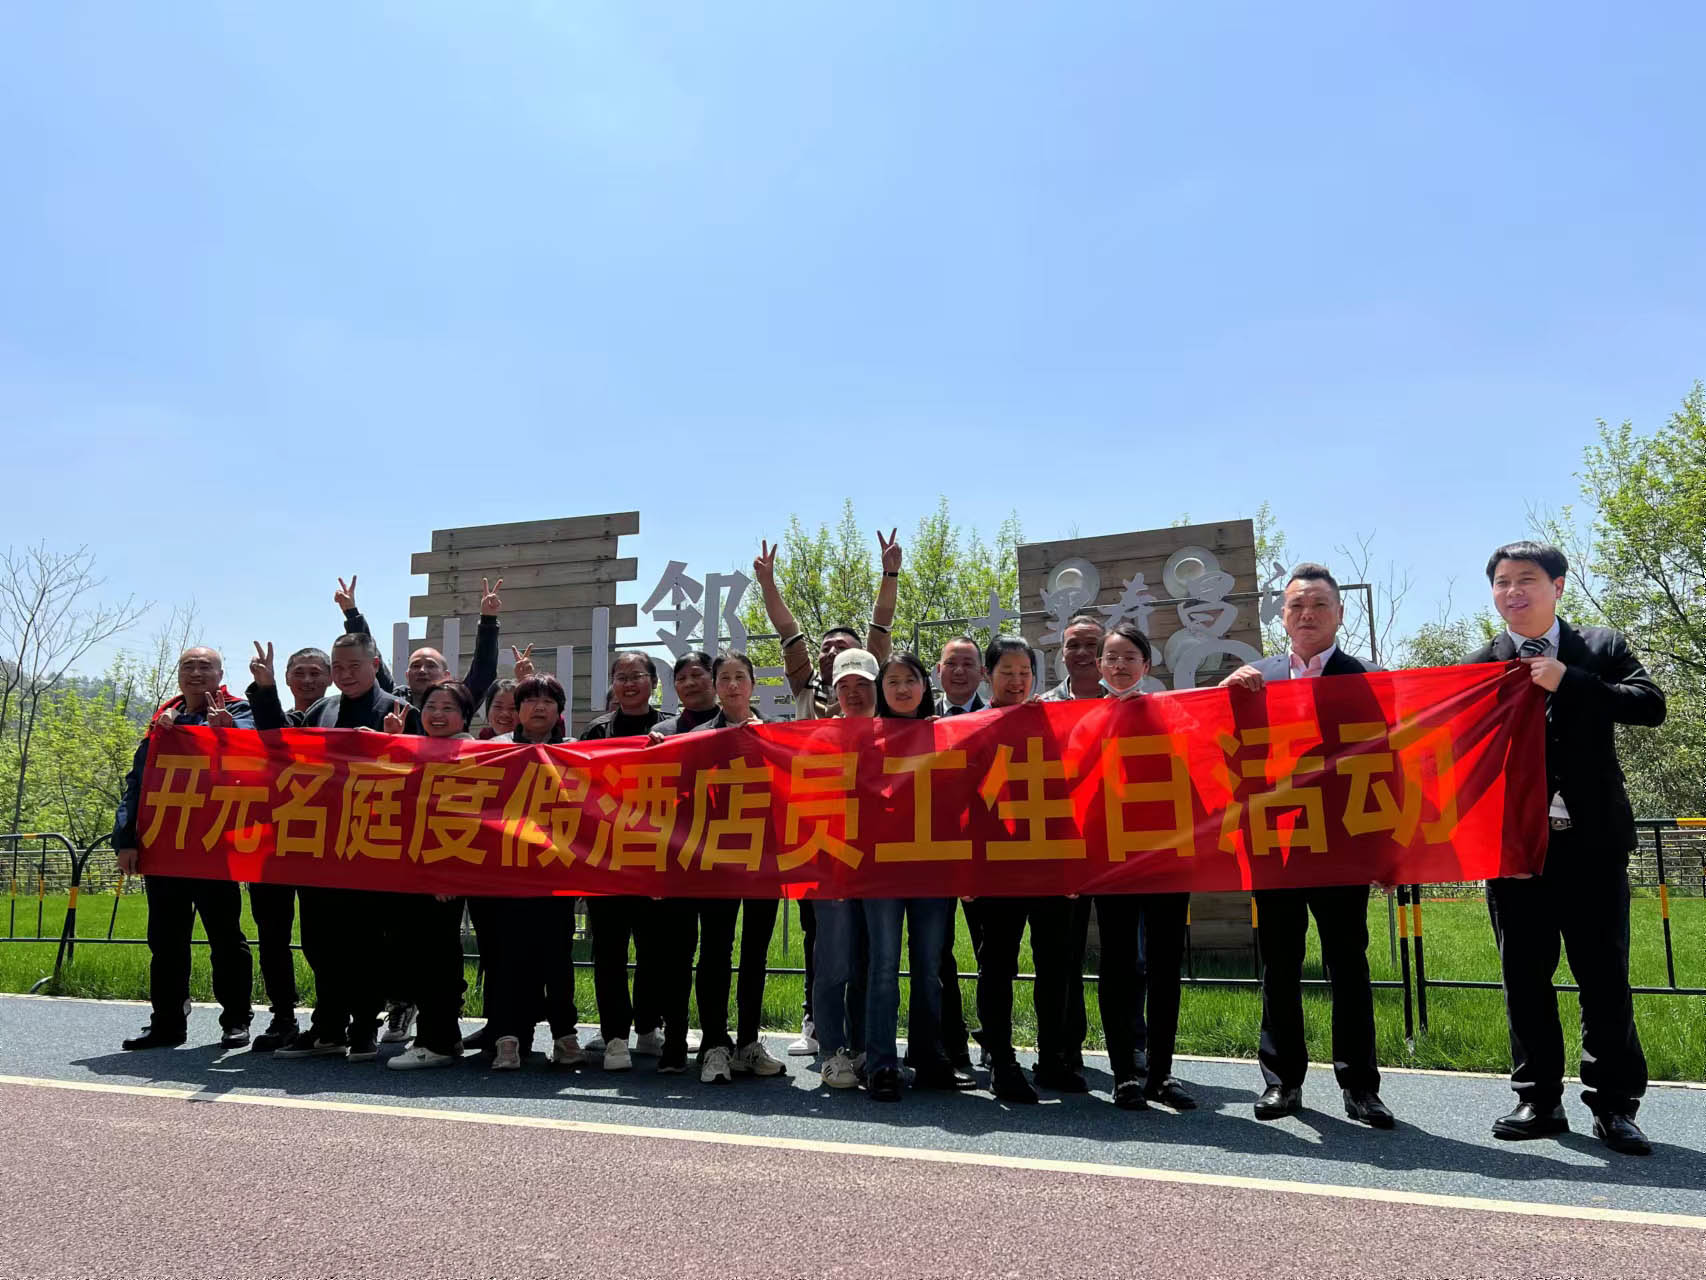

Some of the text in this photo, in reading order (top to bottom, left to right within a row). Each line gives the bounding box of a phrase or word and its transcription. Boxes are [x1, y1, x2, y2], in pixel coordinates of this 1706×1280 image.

[142, 710, 1457, 871] 开元名庭度假酒店员工生日活动
